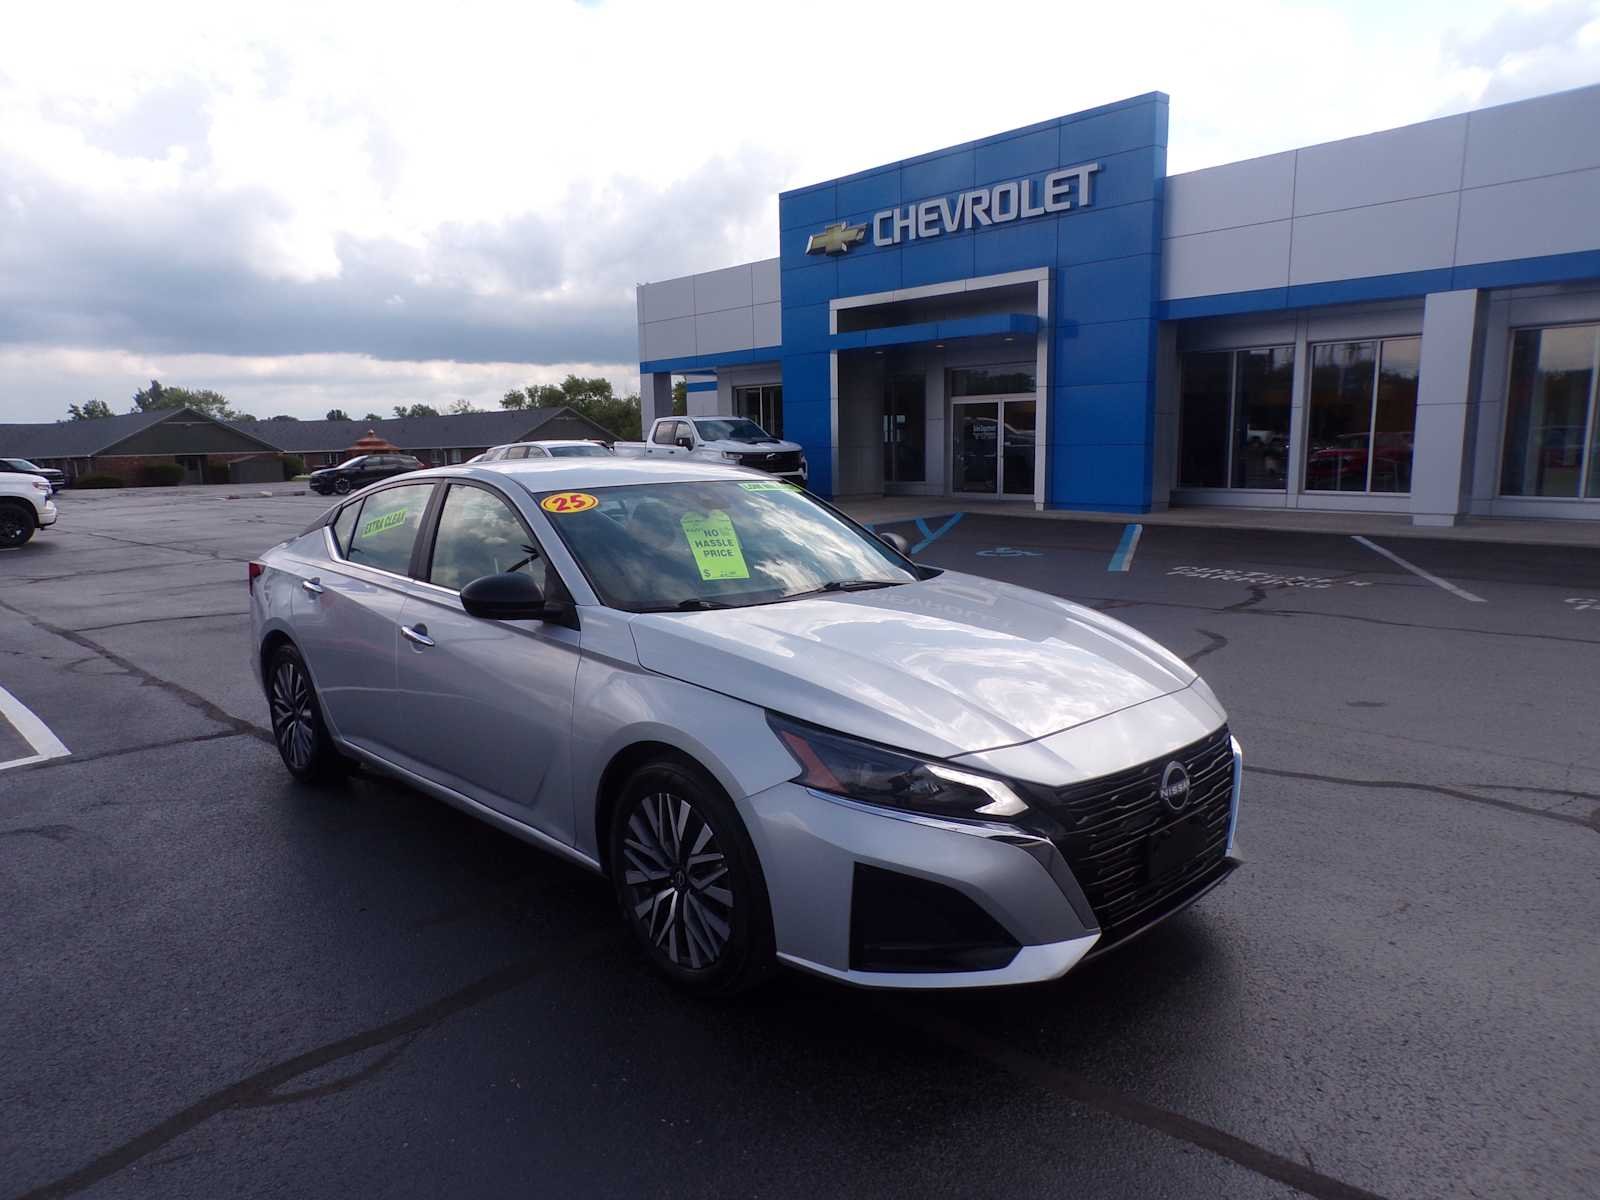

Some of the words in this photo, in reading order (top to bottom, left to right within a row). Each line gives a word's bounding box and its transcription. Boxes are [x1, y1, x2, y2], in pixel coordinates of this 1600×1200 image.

[873, 163, 1098, 247] CHEVROLET
[552, 495, 586, 511] 25
[703, 528, 719, 537] NO
[694, 539, 735, 548] HASSLE
[703, 549, 735, 558] PRICE
[703, 568, 712, 578] $
